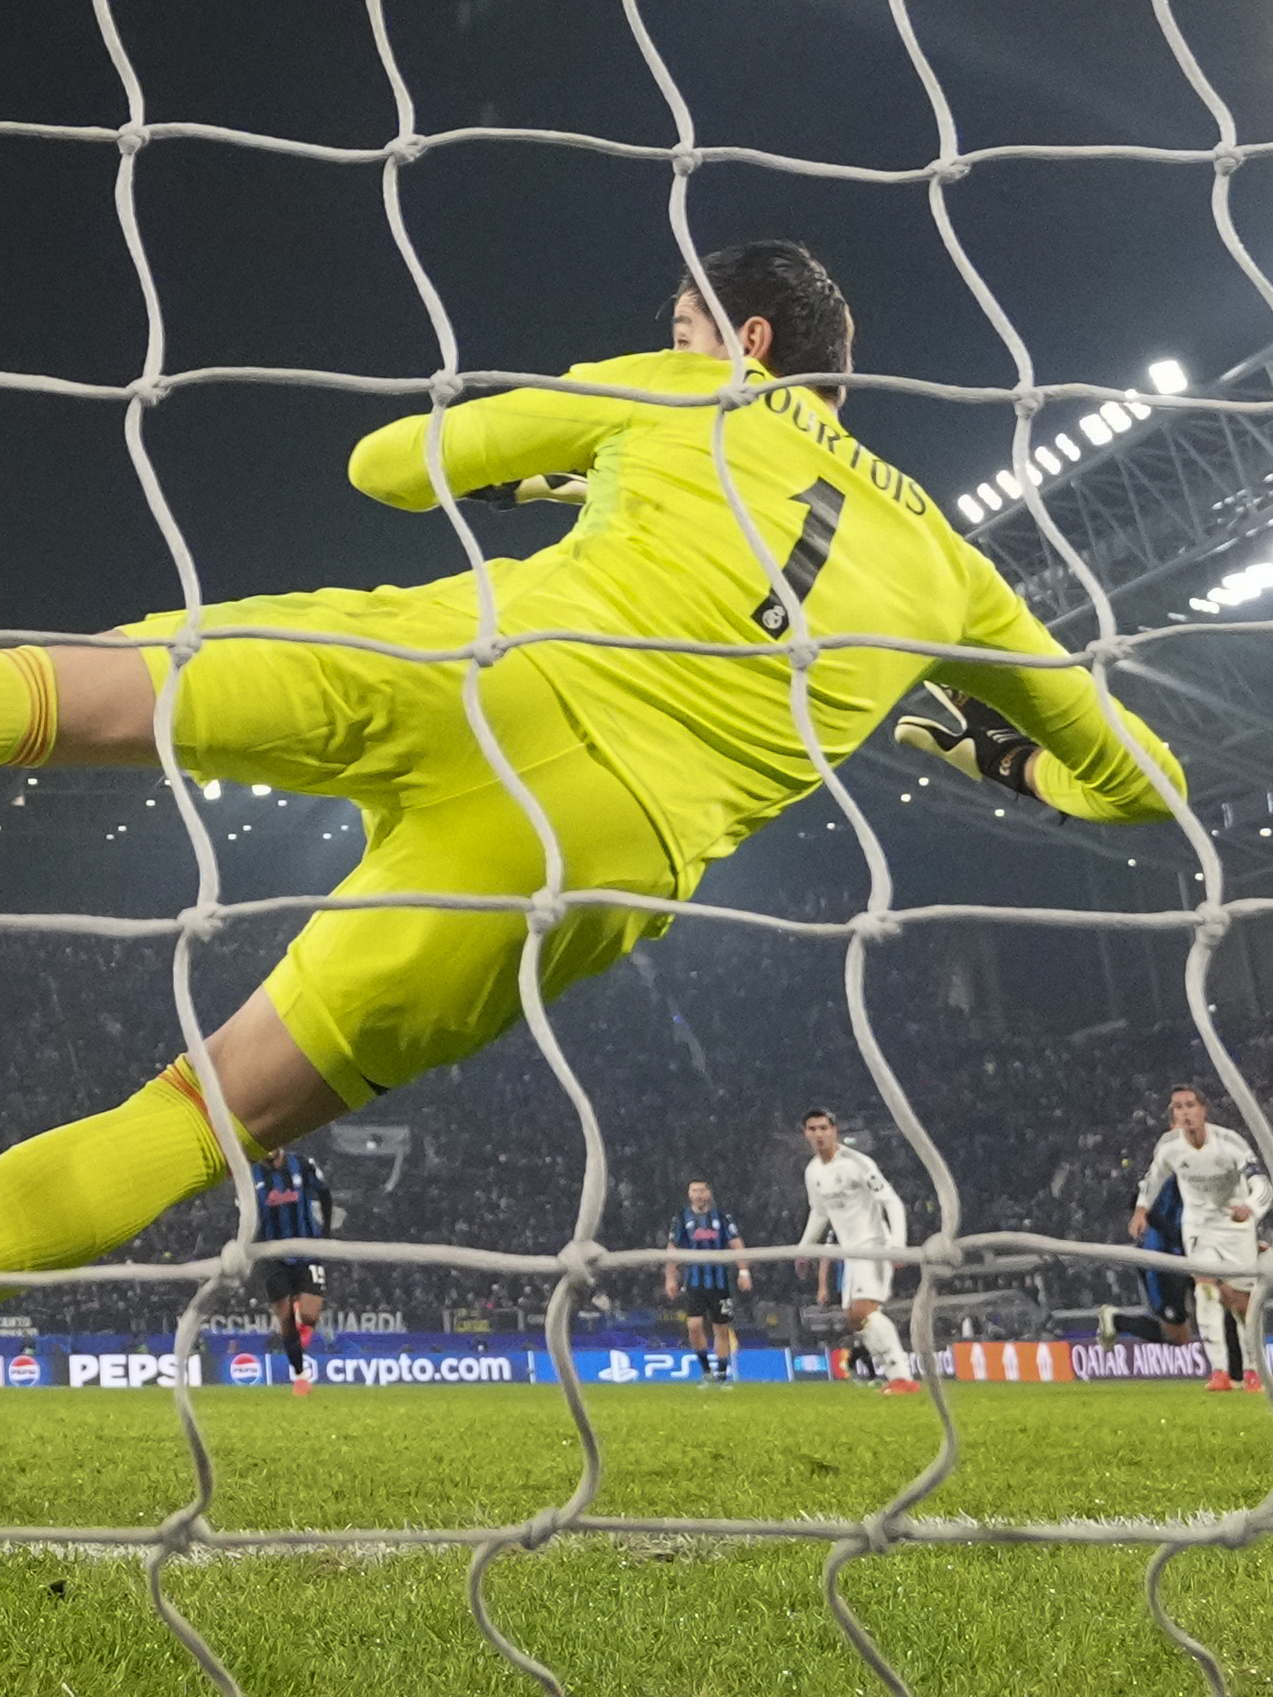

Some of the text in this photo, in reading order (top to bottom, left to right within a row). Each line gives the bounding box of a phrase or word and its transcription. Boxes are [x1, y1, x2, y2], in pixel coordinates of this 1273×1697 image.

[752, 475, 847, 640] 1
[69, 1354, 203, 1388] PEPSI
[326, 1353, 512, 1387] crypto.com
[1071, 1341, 1208, 1382] QATAR AIRWAYS
